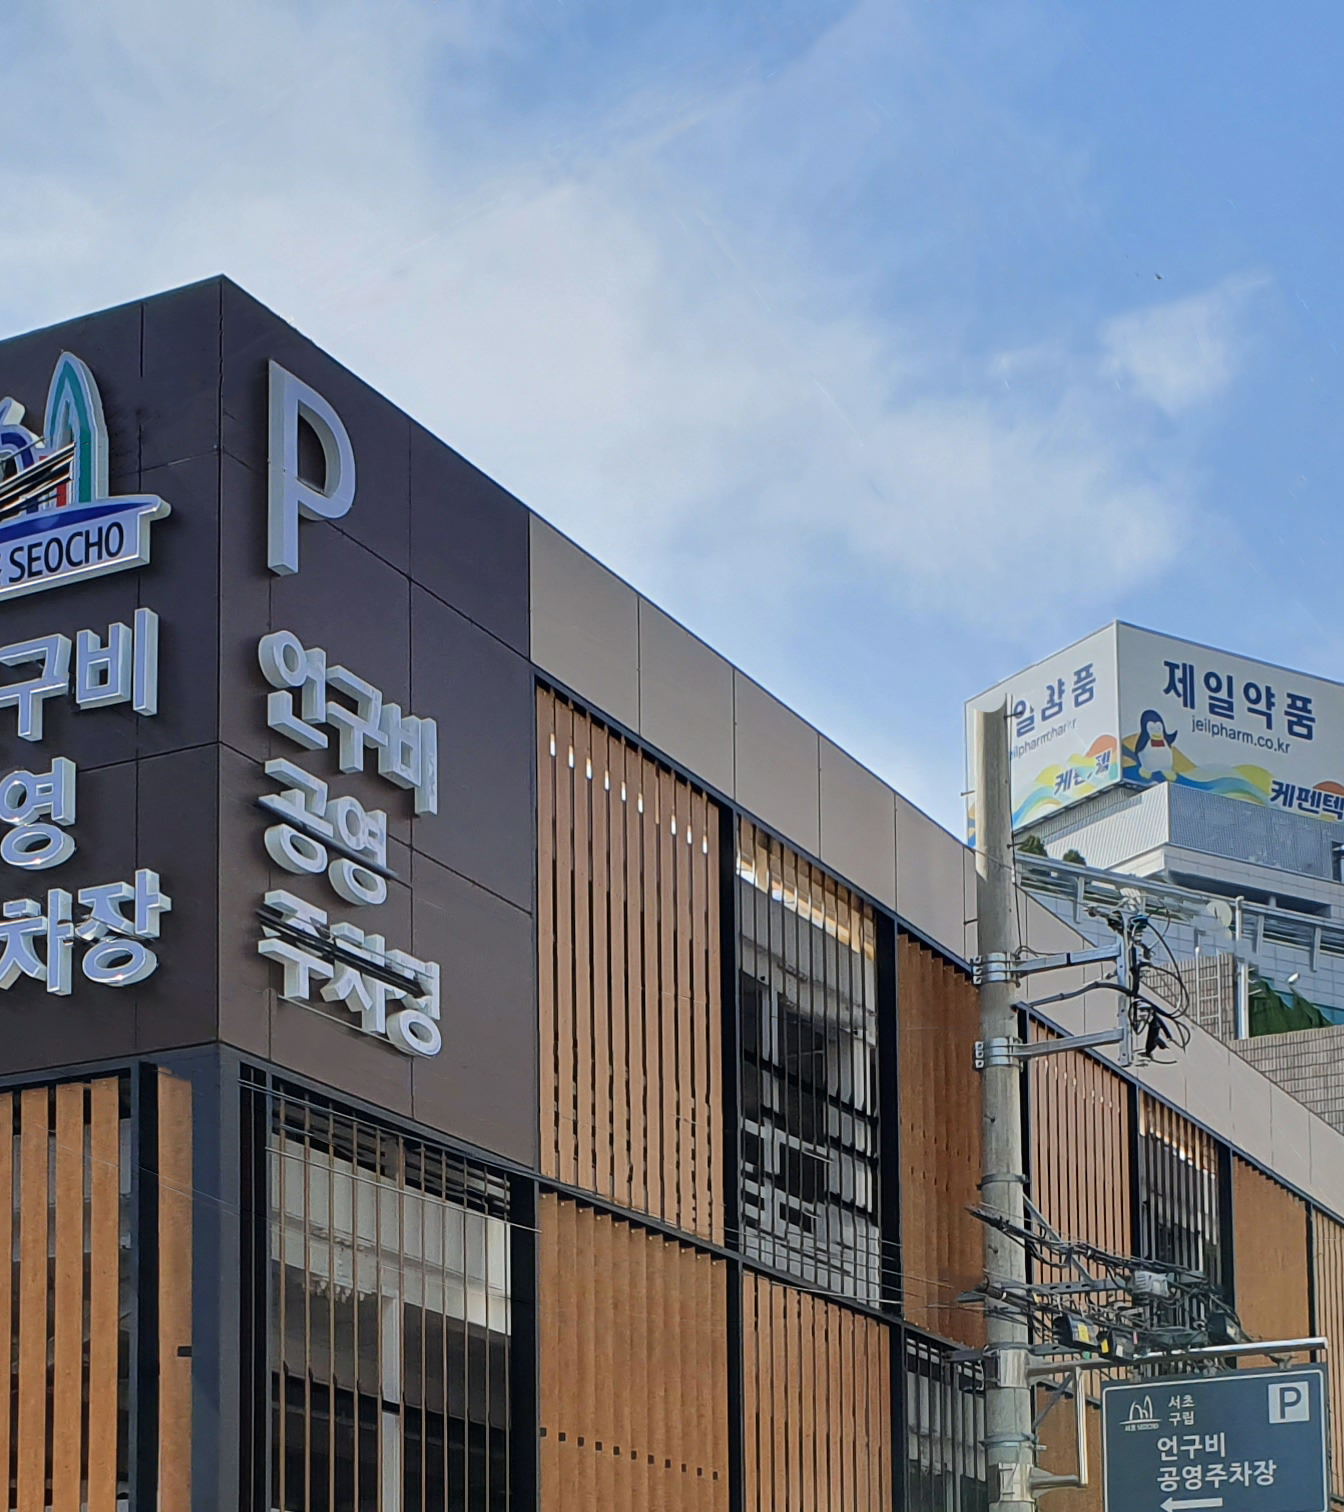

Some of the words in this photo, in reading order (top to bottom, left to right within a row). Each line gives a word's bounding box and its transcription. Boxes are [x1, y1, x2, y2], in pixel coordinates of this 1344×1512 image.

[267, 359, 356, 575] P
[9, 521, 124, 584] SEOCHO
[258, 630, 437, 816] 언구비
[1163, 660, 1316, 741] 제일약품
[1191, 715, 1291, 754] jeilpharm.co.kr
[258, 757, 388, 906] 공영
[258, 889, 442, 1058] 주차장
[1168, 1394, 1195, 1410] 서초
[1168, 1411, 1195, 1427] 구립
[1279, 1386, 1302, 1419] P
[1157, 1432, 1226, 1462] 언구비
[1156, 1459, 1277, 1492] 공영주차장
